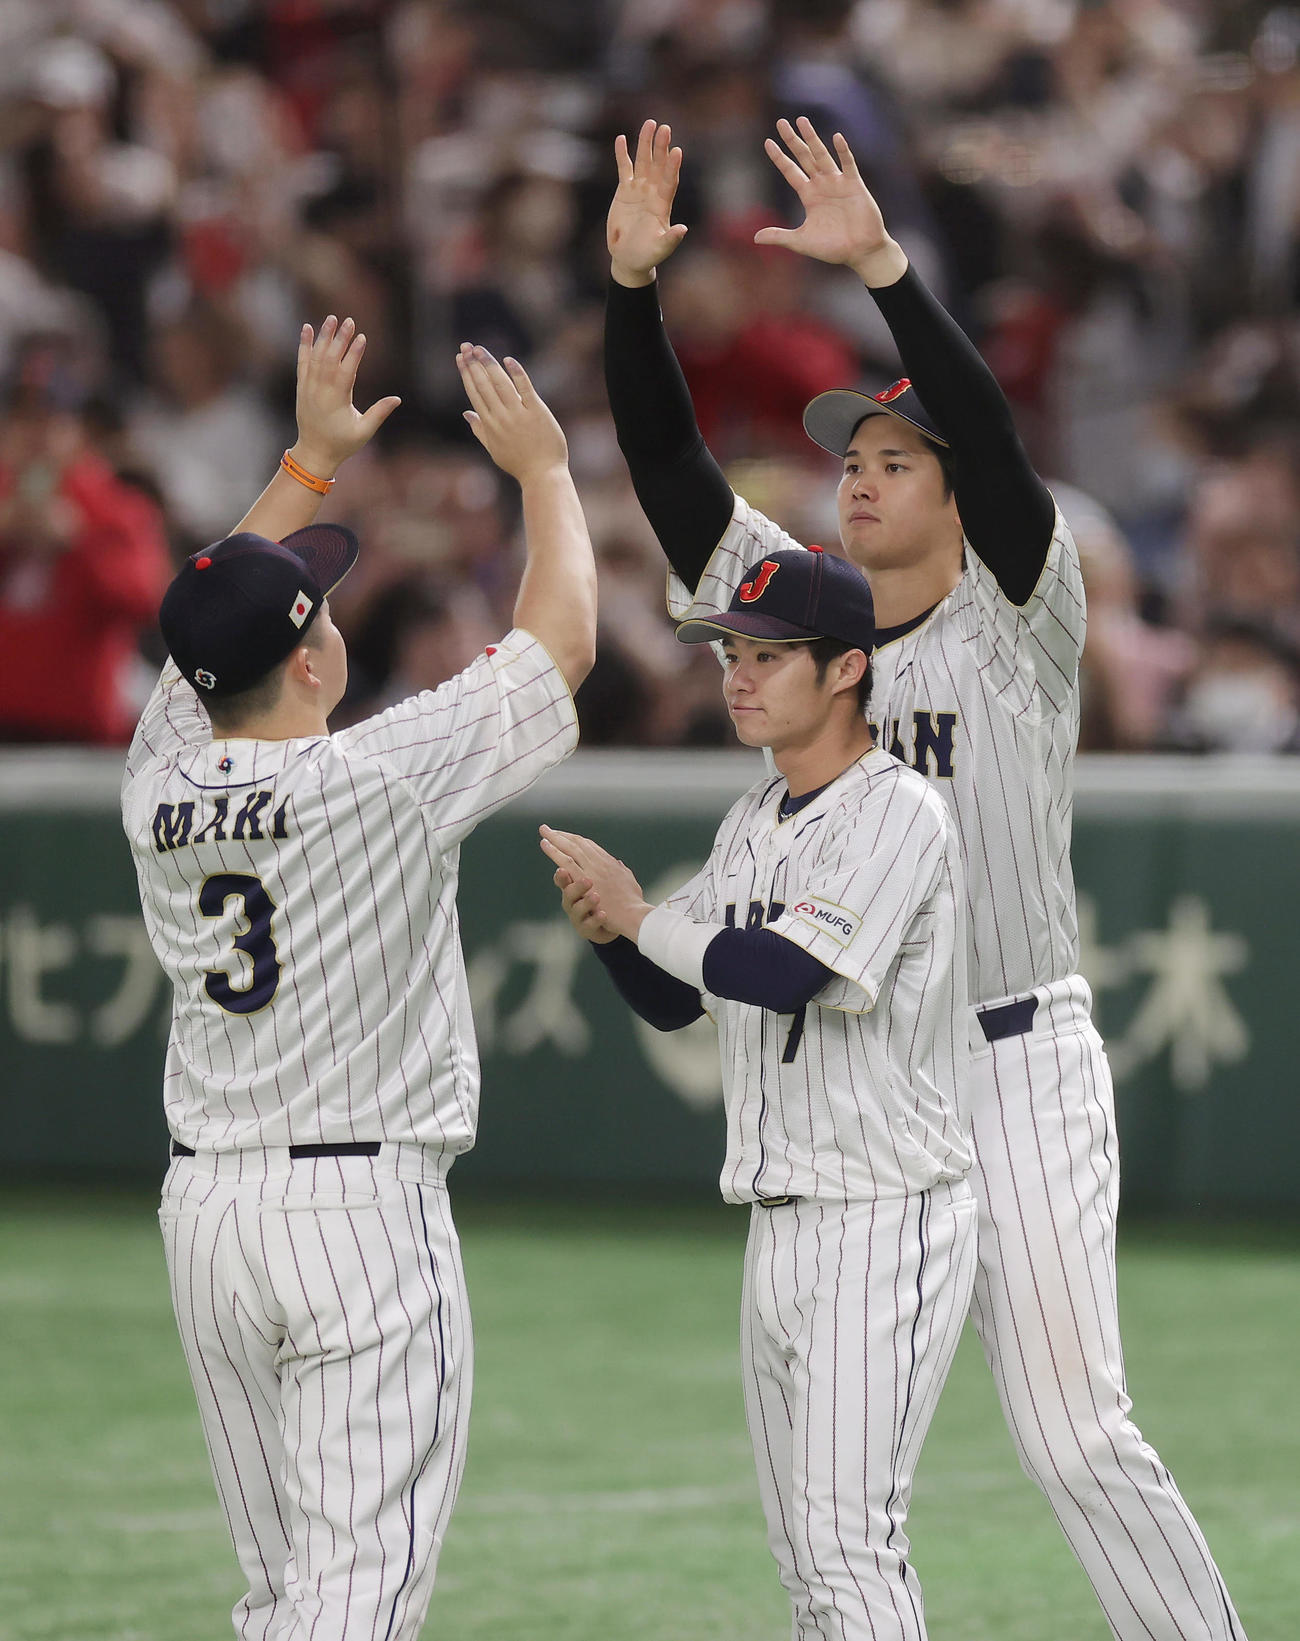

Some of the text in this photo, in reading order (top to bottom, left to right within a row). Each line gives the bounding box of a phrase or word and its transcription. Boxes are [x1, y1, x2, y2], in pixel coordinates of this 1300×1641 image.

[873, 377, 912, 404] J
[739, 560, 780, 603] J
[151, 789, 289, 854] MAKI
[198, 871, 282, 1017] 3
[816, 909, 853, 936] MUFG
